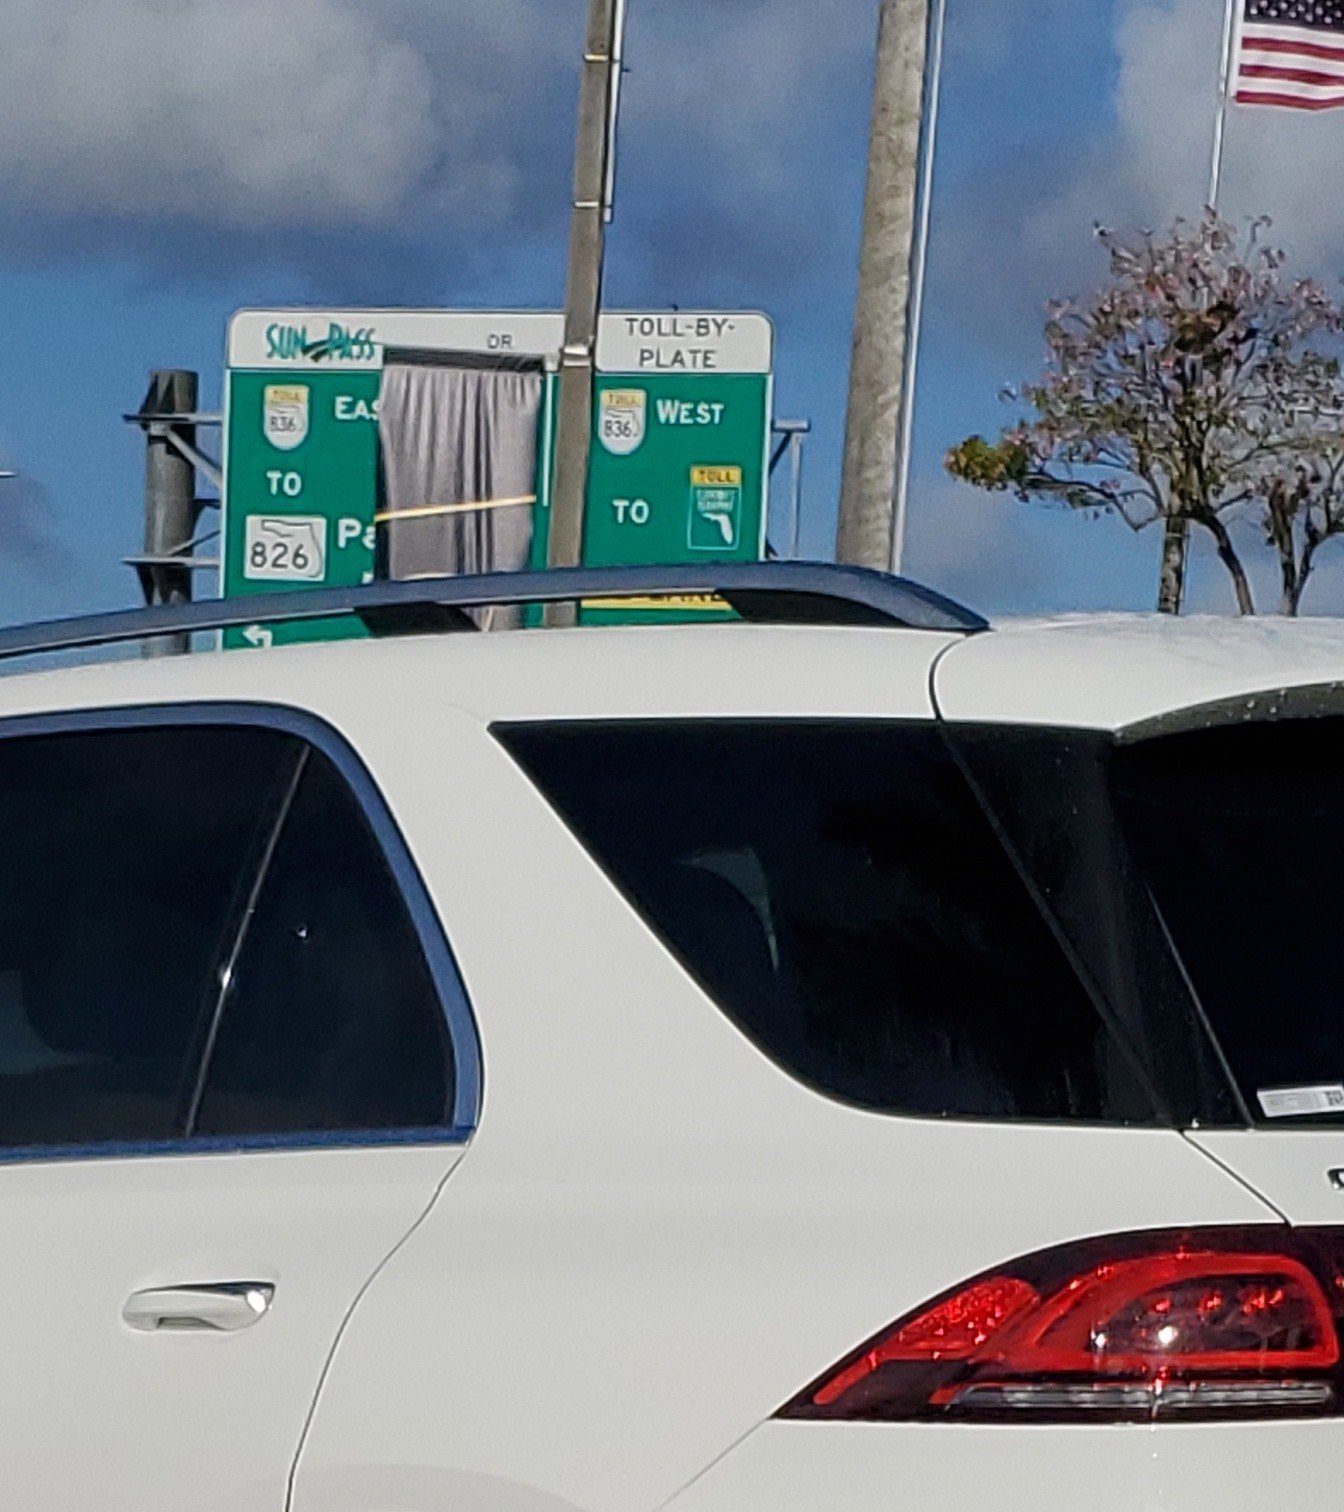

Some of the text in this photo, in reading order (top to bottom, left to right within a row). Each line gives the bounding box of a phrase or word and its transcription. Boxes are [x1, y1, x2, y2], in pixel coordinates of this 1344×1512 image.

[625, 317, 735, 337] TOLL-BY-
[487, 334, 513, 349] OR
[639, 349, 717, 368] PLATE
[656, 399, 725, 424] WEST
[604, 420, 632, 438] 836
[266, 470, 302, 496] TO
[612, 499, 650, 524] TO
[250, 541, 309, 569] 826
